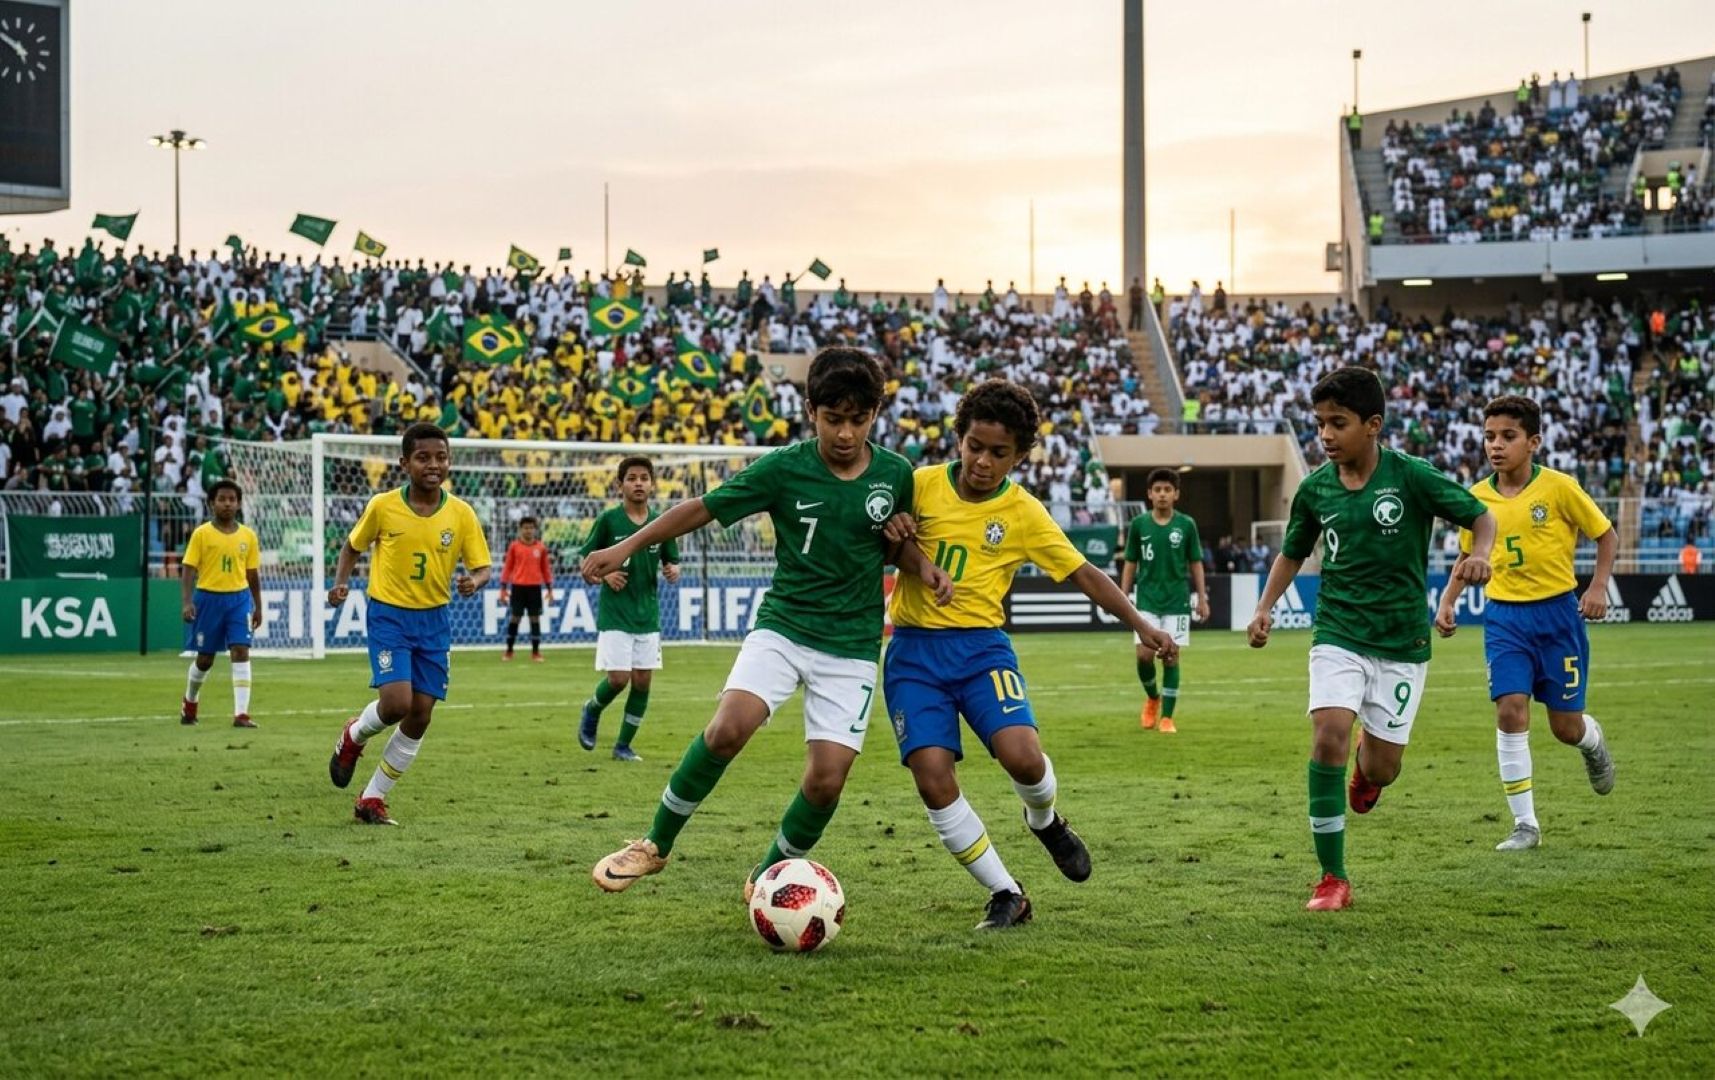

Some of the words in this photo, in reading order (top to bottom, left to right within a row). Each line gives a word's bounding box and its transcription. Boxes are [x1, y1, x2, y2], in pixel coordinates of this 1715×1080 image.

[800, 516, 818, 554] 7
[1141, 543, 1154, 561] 16
[1325, 528, 1340, 562] 9
[1506, 535, 1524, 569] 5
[410, 552, 427, 580] 3
[935, 540, 968, 582] 10
[21, 597, 117, 639] KSA
[1646, 605, 1694, 623] adidas
[989, 670, 1024, 702] 10
[1564, 656, 1579, 689] 5
[860, 684, 873, 721] 7
[1394, 682, 1411, 716] 9
